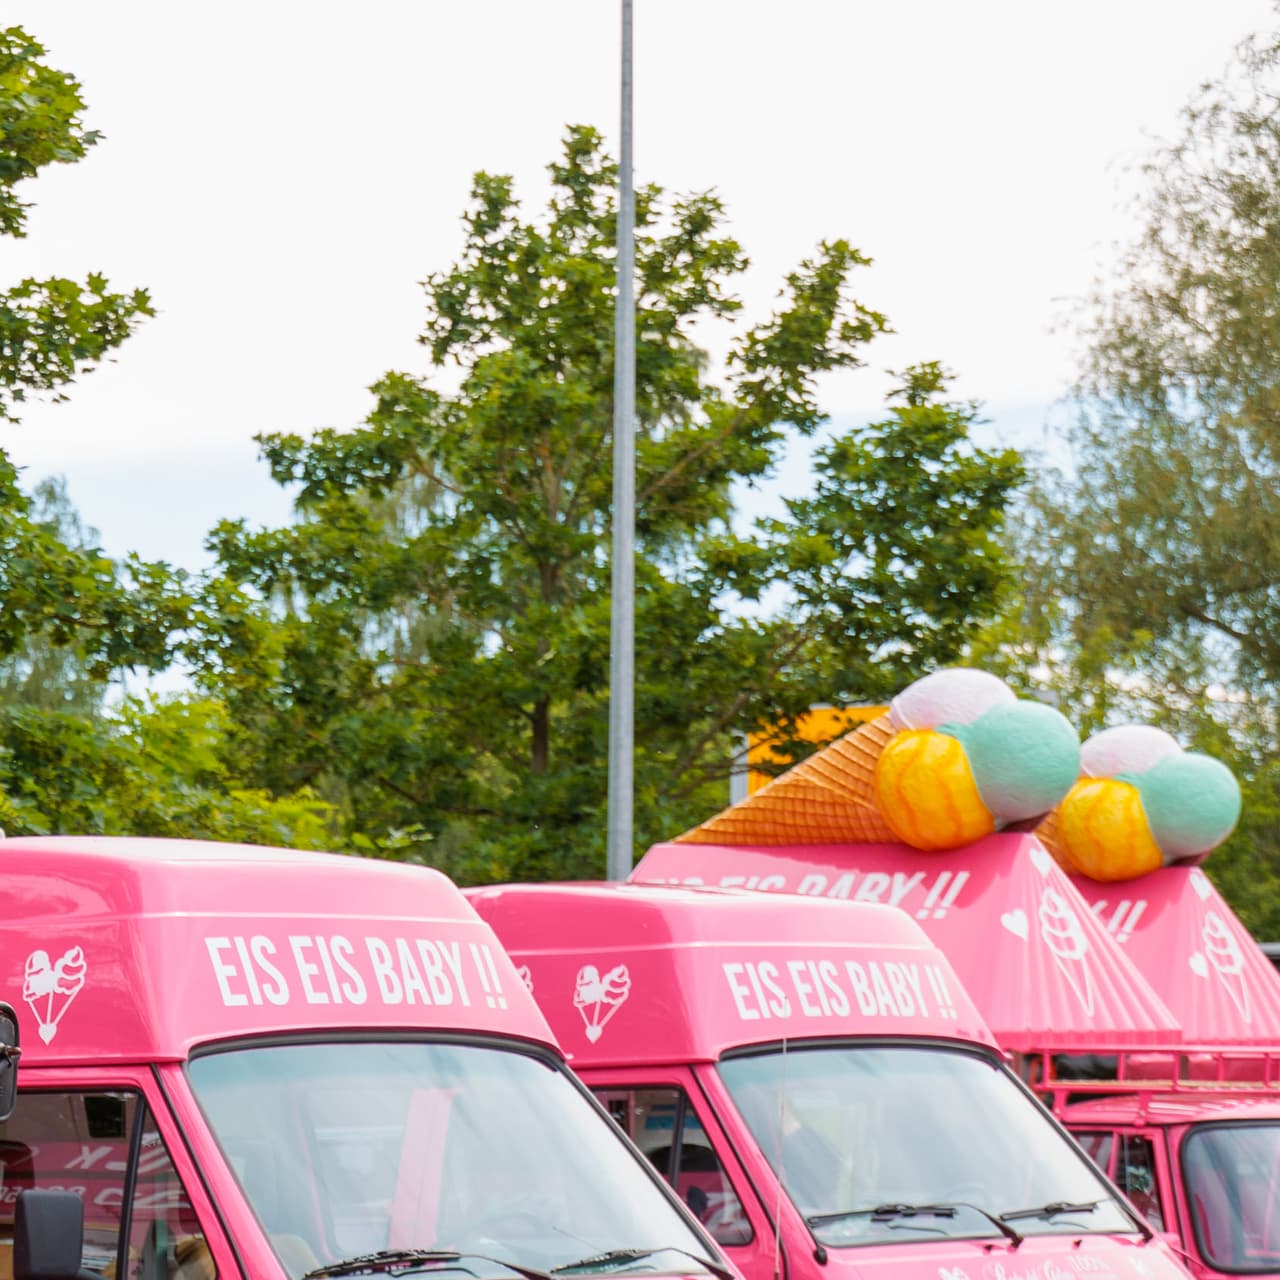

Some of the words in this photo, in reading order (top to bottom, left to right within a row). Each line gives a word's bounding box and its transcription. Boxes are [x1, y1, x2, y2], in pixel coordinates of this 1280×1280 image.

[205, 935, 290, 1008] EIS
[291, 934, 368, 1008] EIS
[366, 937, 471, 1008] BABY
[475, 944, 509, 1010] !!
[723, 960, 791, 1021] EIS
[788, 959, 851, 1019] EIS
[848, 960, 927, 1018] BABY
